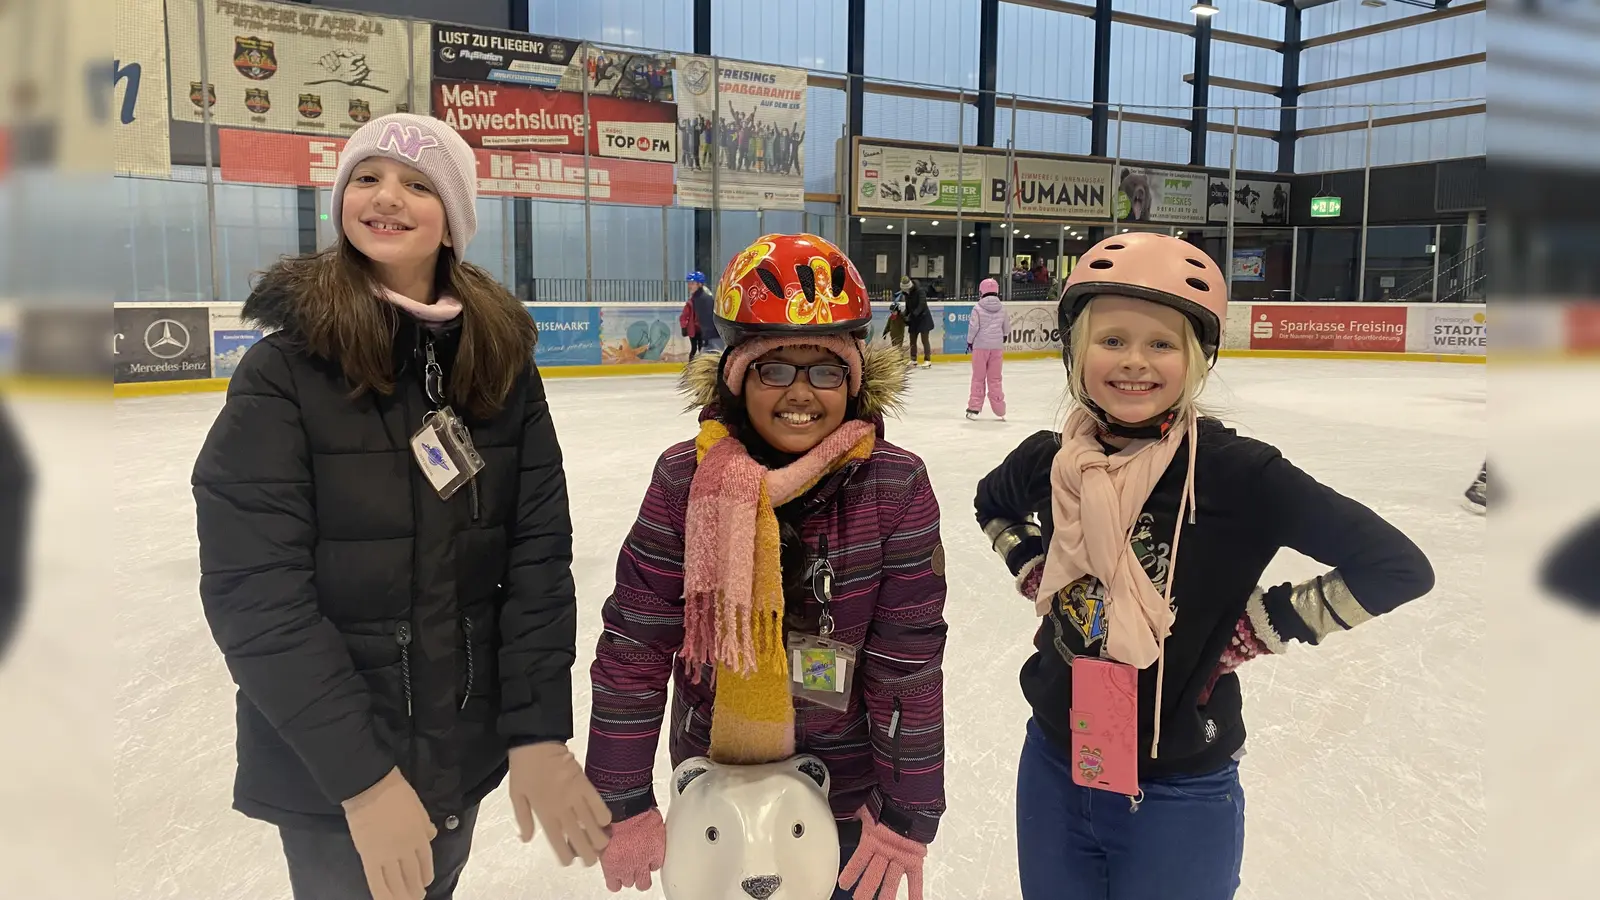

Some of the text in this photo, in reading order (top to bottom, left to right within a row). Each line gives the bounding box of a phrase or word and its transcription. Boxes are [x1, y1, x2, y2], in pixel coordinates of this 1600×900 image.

[438, 30, 470, 45] LUST
[471, 33, 488, 48] ZU
[490, 36, 545, 54] FLIEGEN?
[718, 68, 777, 84] FREISINGS
[441, 84, 498, 107] Mehr
[605, 134, 671, 153] TOP FM
[991, 160, 1104, 209] BAUMANN
[1021, 172, 1053, 181] ZIMMEREI
[941, 184, 977, 195] REIER
[1279, 319, 1405, 336] Sparkasse Freising
[1433, 325, 1484, 335] STADT
[1433, 336, 1487, 347] WERKE
[129, 361, 207, 374] Mercedes-Benz
